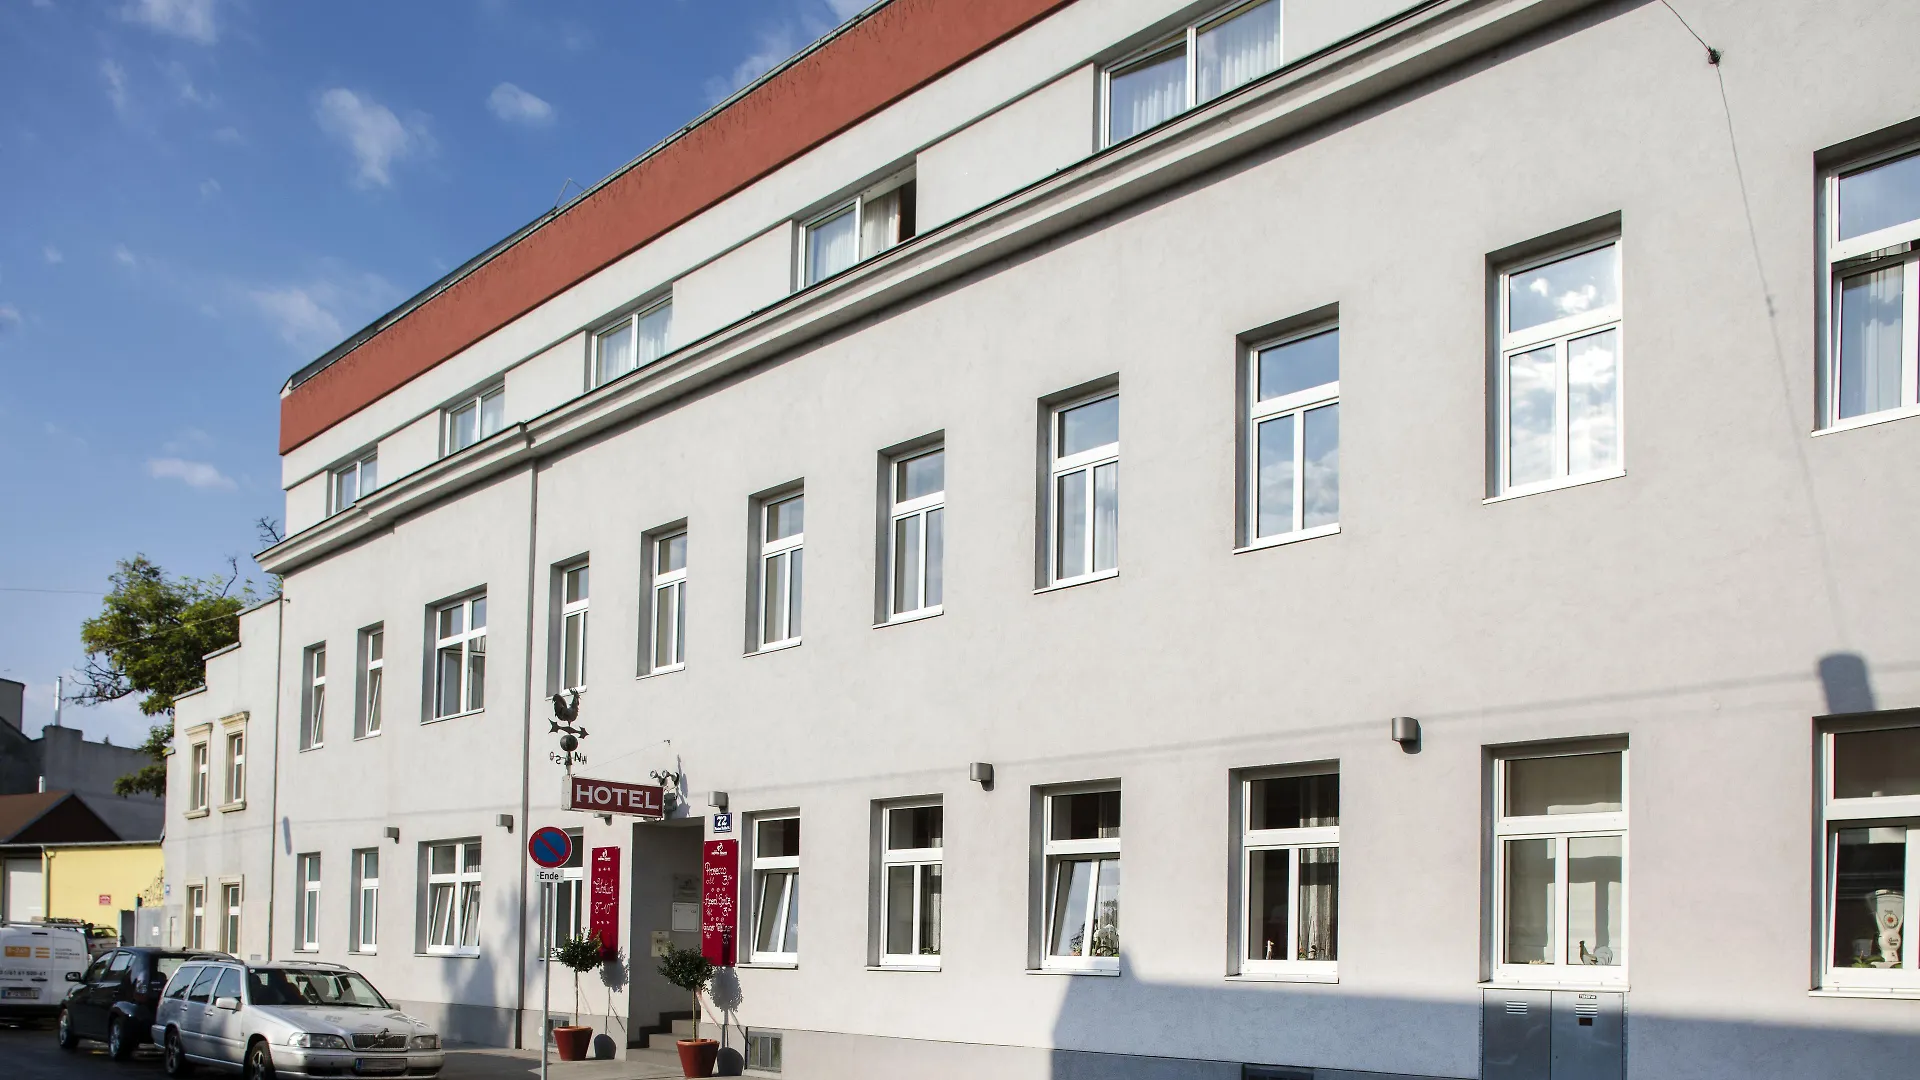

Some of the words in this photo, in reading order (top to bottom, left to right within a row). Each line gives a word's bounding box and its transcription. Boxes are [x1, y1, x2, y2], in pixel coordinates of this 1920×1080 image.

[576, 784, 660, 810] HOTEL
[716, 815, 728, 827] 72
[539, 871, 559, 880] Ende
